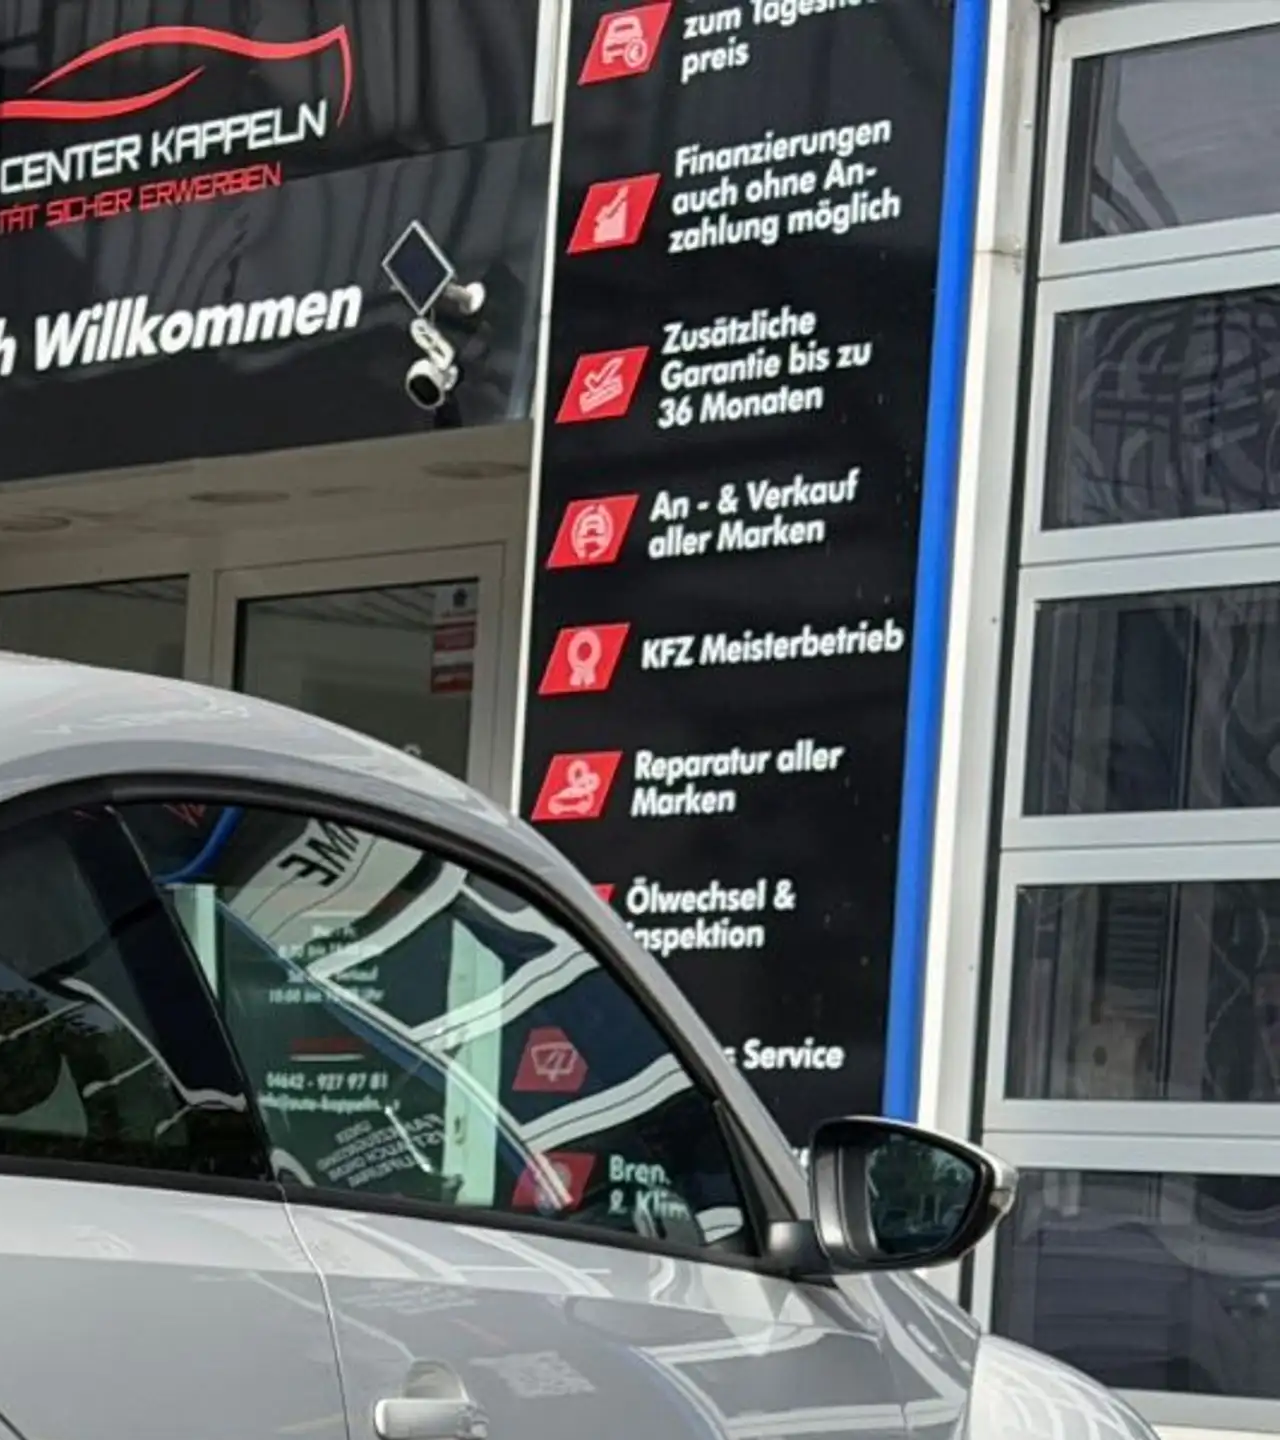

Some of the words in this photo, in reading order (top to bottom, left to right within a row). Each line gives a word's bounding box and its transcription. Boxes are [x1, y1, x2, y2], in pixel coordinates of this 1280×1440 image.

[683, 7, 742, 39] zum
[681, 38, 749, 83] preis
[0, 136, 142, 196] CENTER
[150, 99, 327, 166] KAPPELN
[675, 117, 893, 179] Finanzierungen
[46, 185, 132, 229] SICHER
[138, 161, 283, 213] ERWERBEN
[671, 180, 739, 217] auch
[745, 169, 817, 206] ohne
[823, 159, 878, 190] An-
[667, 210, 779, 254] zahlung
[787, 189, 902, 235] möglich
[33, 283, 364, 371] Willkommen
[661, 305, 816, 356] Zusätzliche
[660, 347, 780, 392] Garantie
[787, 341, 830, 374] bis
[836, 343, 873, 369] zu
[656, 395, 694, 430] 36
[699, 382, 824, 424] Monaten
[649, 488, 689, 524] An
[716, 483, 739, 514] &
[747, 468, 862, 513] Verkauf
[647, 522, 711, 561] aller
[717, 515, 826, 553] Marken
[640, 637, 693, 671] KFZ
[698, 619, 905, 667] Meisterbetrieb
[634, 747, 771, 787] Reparatur
[777, 739, 845, 774] aller
[631, 783, 736, 818] Marken
[625, 877, 766, 914] Ölwechsel
[773, 879, 797, 911] &
[627, 918, 765, 957] nspektion
[743, 1037, 844, 1070] Service
